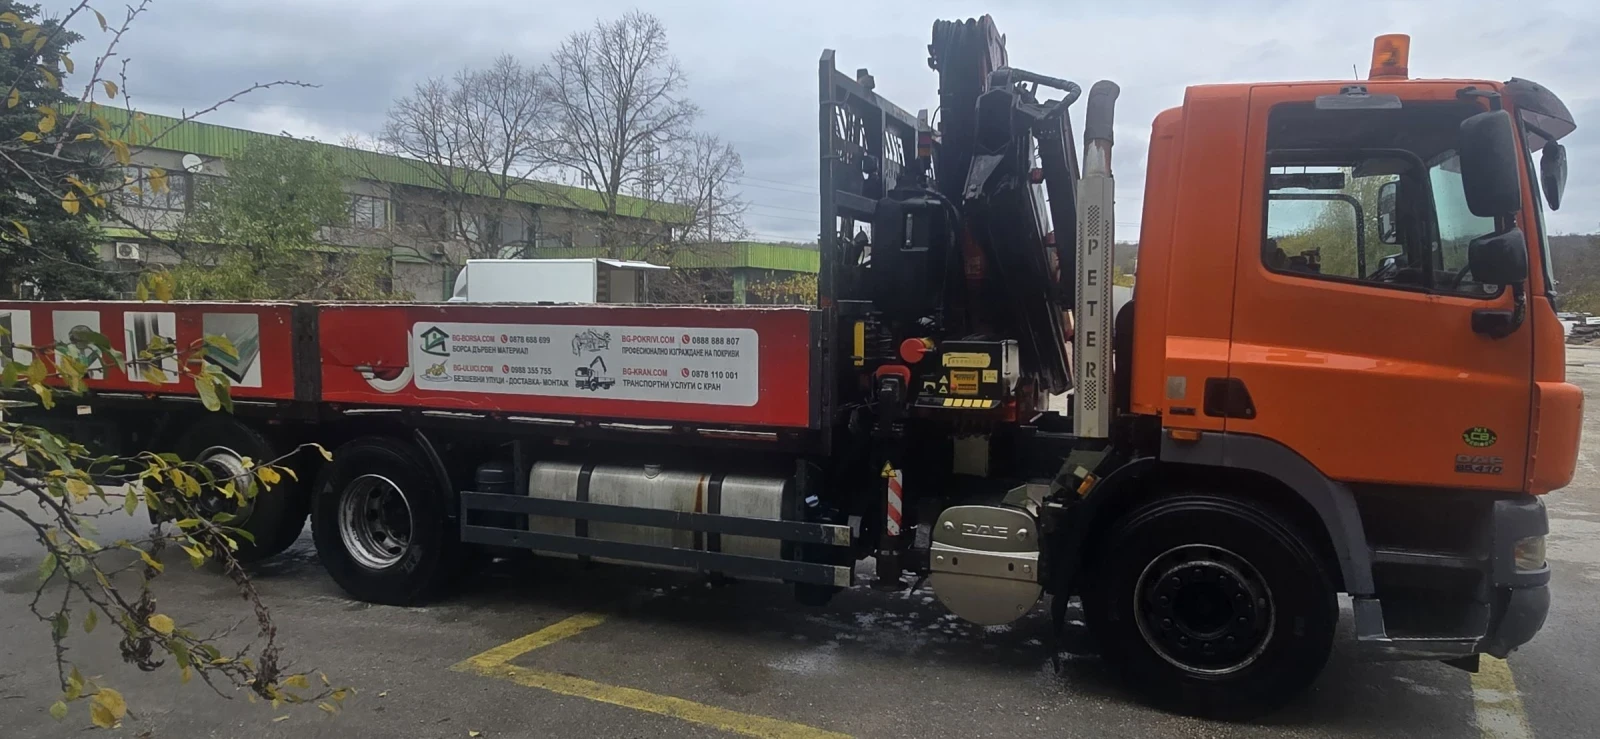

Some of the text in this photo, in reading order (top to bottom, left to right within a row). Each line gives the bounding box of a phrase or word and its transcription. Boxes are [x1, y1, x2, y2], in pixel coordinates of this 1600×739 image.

[1085, 238, 1099, 378] PETER
[452, 334, 495, 343] BG-BORSA.COM
[509, 336, 524, 344] 0878
[622, 334, 740, 346] BG-POKRIVI.COM 0888 888 807
[452, 345, 528, 355] БОРСА ДЪРВЕН МАТЕРИАЛ
[622, 346, 740, 358] ПРОФЕСИОНАЛНО ИЗГРАЖДАНЕ НА ПОКРИВИ
[453, 364, 494, 373] BG-ULUCI.COM
[511, 366, 527, 374] 0988
[540, 367, 552, 375] 755
[622, 368, 738, 380] BG-KRAN.COM 0878 110 001
[454, 374, 485, 383] БЕЗШЕВНИ
[543, 378, 569, 387] МОНТАЖ
[622, 379, 670, 389] ТРАНСПОРТНИ
[671, 380, 696, 390] УСЛУГИ
[703, 382, 721, 391] КРАН
[1470, 432, 1490, 440] CB
[1456, 454, 1504, 464] DAF
[962, 523, 1008, 539] DAF
